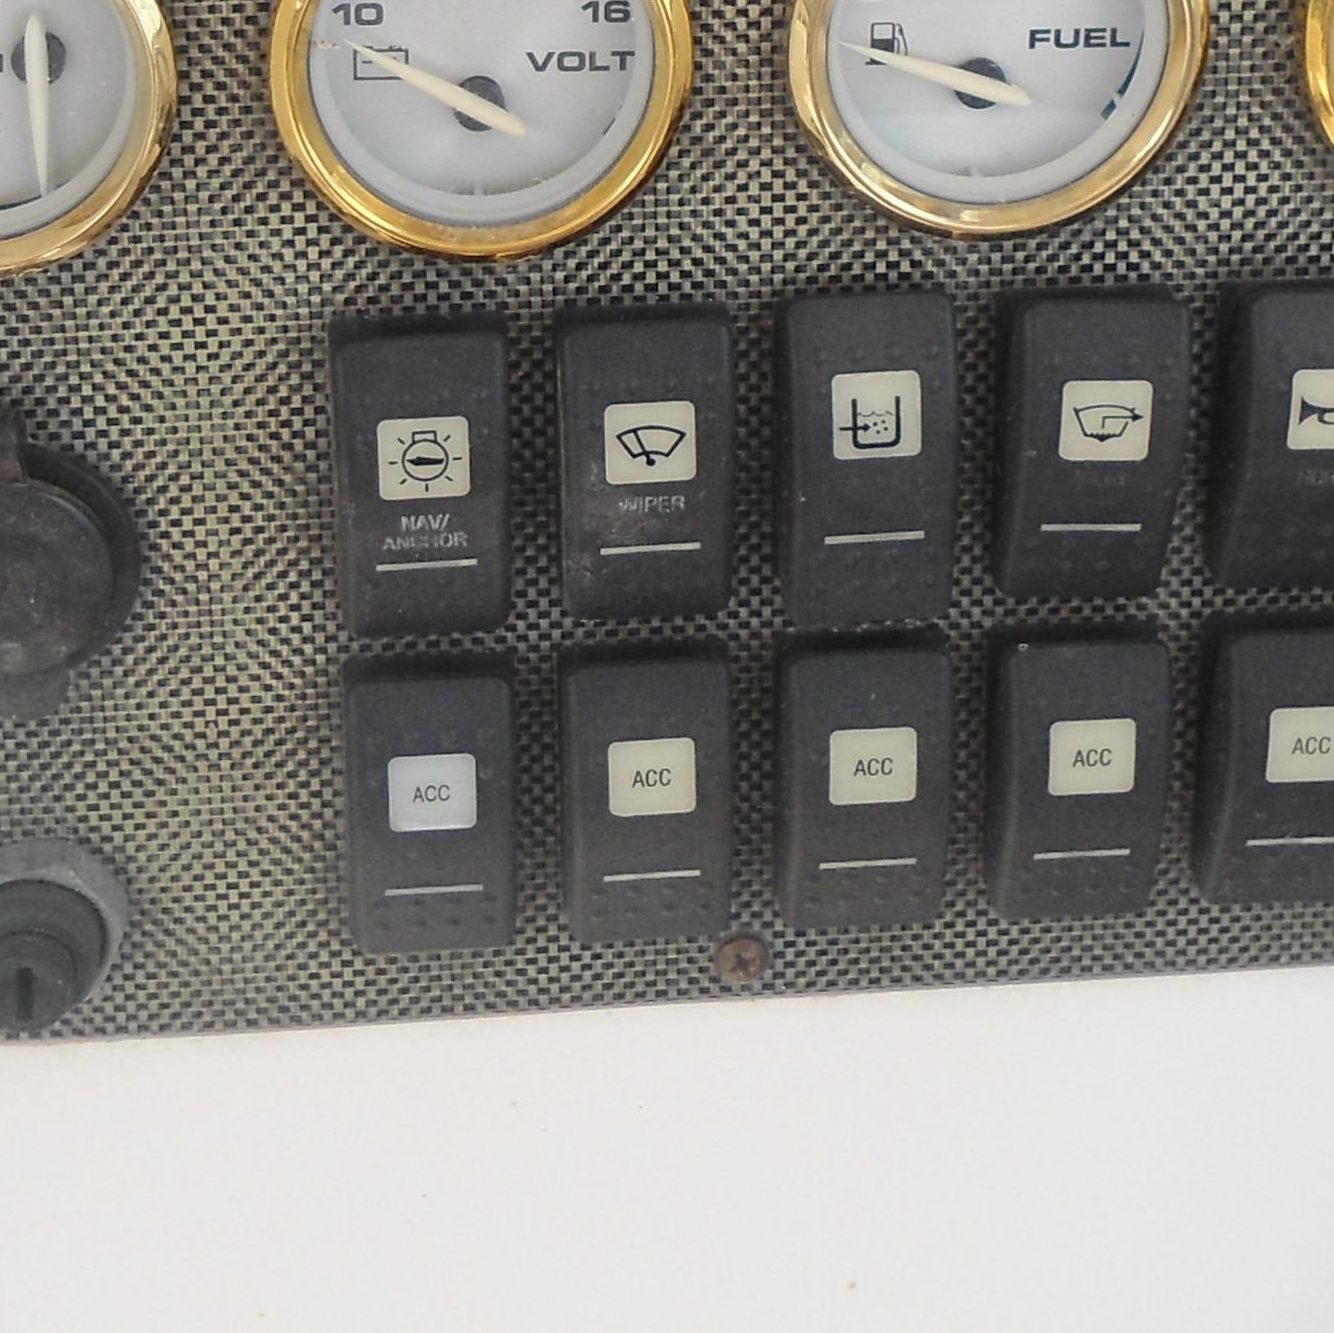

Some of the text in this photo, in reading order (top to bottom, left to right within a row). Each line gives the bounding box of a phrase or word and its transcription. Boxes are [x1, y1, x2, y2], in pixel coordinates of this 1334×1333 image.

[331, 2, 385, 26] 10
[581, 0, 631, 23] 16
[1028, 27, 1131, 50] FUEL
[526, 50, 636, 72] VOLT
[1292, 736, 1331, 756] ACC
[853, 757, 893, 777] ACC
[1072, 748, 1113, 767] ACC
[632, 768, 672, 788] ACC
[412, 784, 451, 804] ACC
